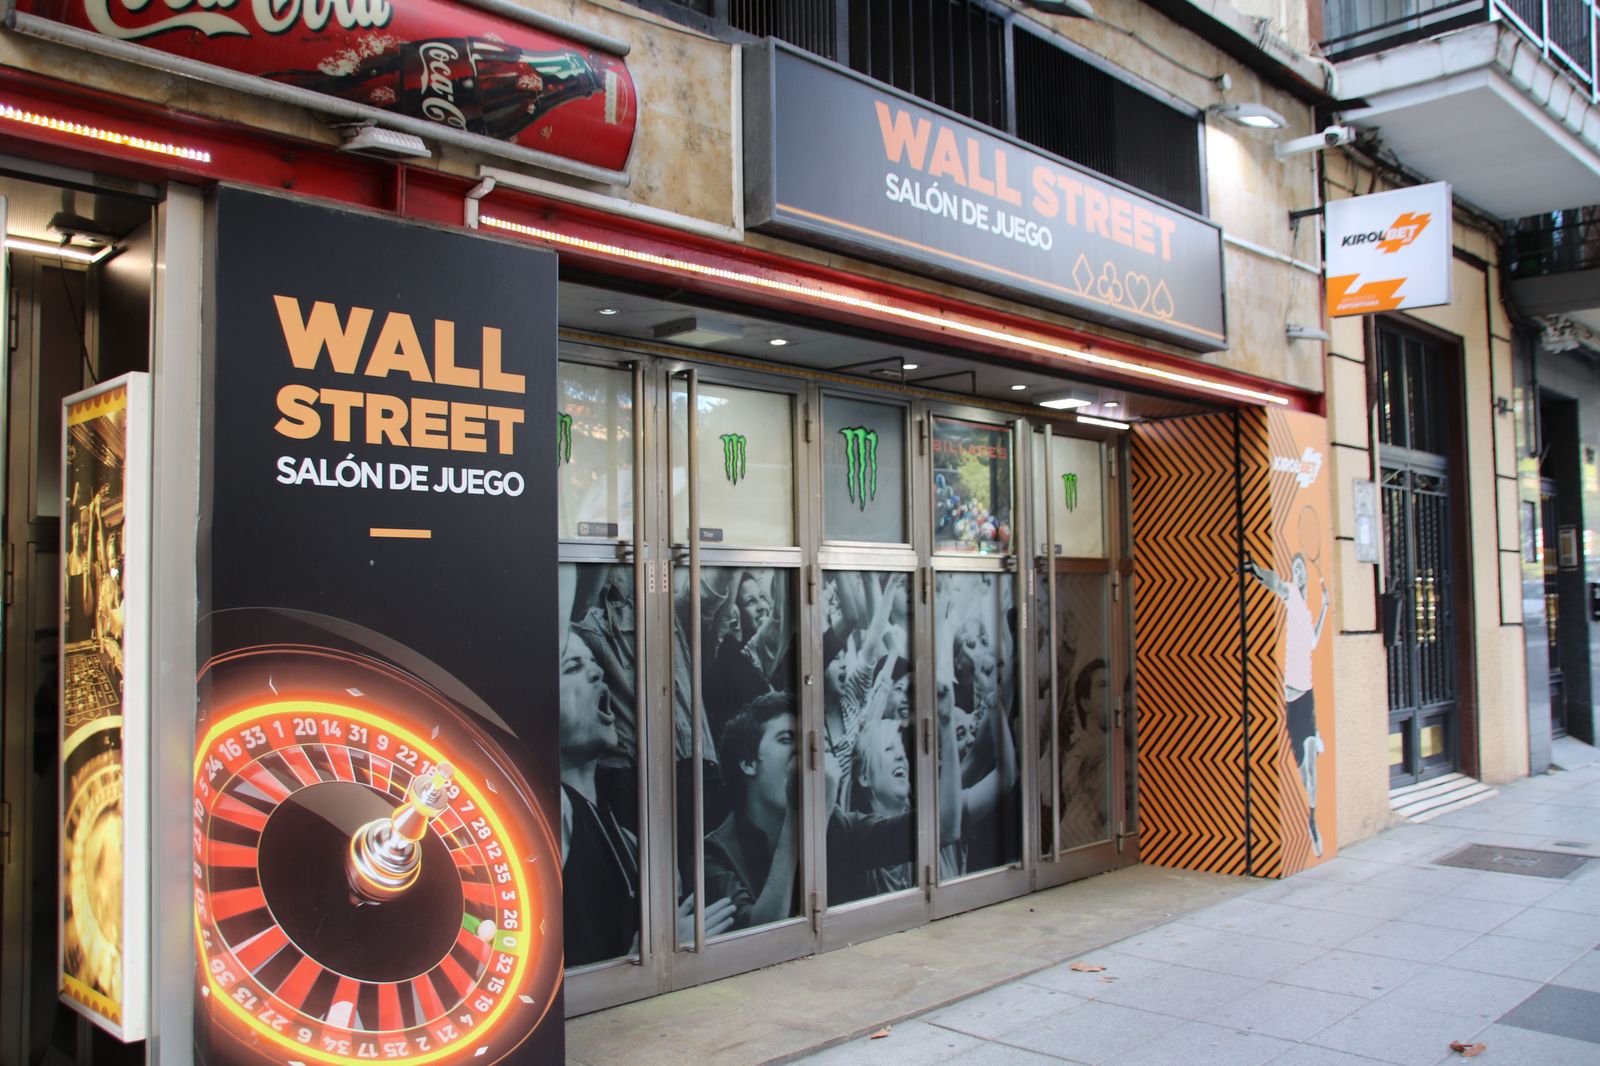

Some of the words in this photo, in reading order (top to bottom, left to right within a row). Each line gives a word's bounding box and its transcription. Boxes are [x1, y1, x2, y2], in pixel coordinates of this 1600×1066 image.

[874, 100, 1022, 206] WALL
[1032, 165, 1176, 261] STREET
[886, 172, 958, 220] SALÓN
[962, 198, 988, 230] DE
[991, 211, 1053, 250] JUEGO
[273, 294, 526, 394] WALL
[274, 384, 525, 455] STREET
[276, 453, 383, 490] SALÓN
[389, 463, 429, 492] DE
[433, 467, 525, 497] JUEGO
[272, 720, 285, 738] 1
[293, 717, 318, 736] 20
[321, 719, 341, 738] 14
[348, 723, 368, 744] 31
[240, 725, 267, 749] 33
[376, 734, 389, 751] 9
[218, 737, 242, 761] 16
[395, 744, 418, 767] 22
[205, 754, 224, 782] 24
[460, 800, 475, 812] 7
[471, 817, 492, 840] 28
[485, 840, 502, 860] 12
[494, 862, 512, 884] 35
[502, 890, 516, 901] 3
[503, 908, 518, 929] 26
[502, 936, 517, 948] 0
[209, 958, 236, 987] 36
[496, 953, 515, 974] 32
[487, 976, 505, 994] 15
[232, 987, 258, 1010] 13
[474, 995, 494, 1013] 19
[258, 1009, 289, 1031] 27
[460, 1014, 474, 1027] 4
[297, 1027, 312, 1044] 6
[415, 1036, 431, 1051] 2
[436, 1024, 458, 1043] 21
[322, 1035, 350, 1055] 34
[357, 1042, 378, 1058] 17
[384, 1041, 410, 1058] 25
